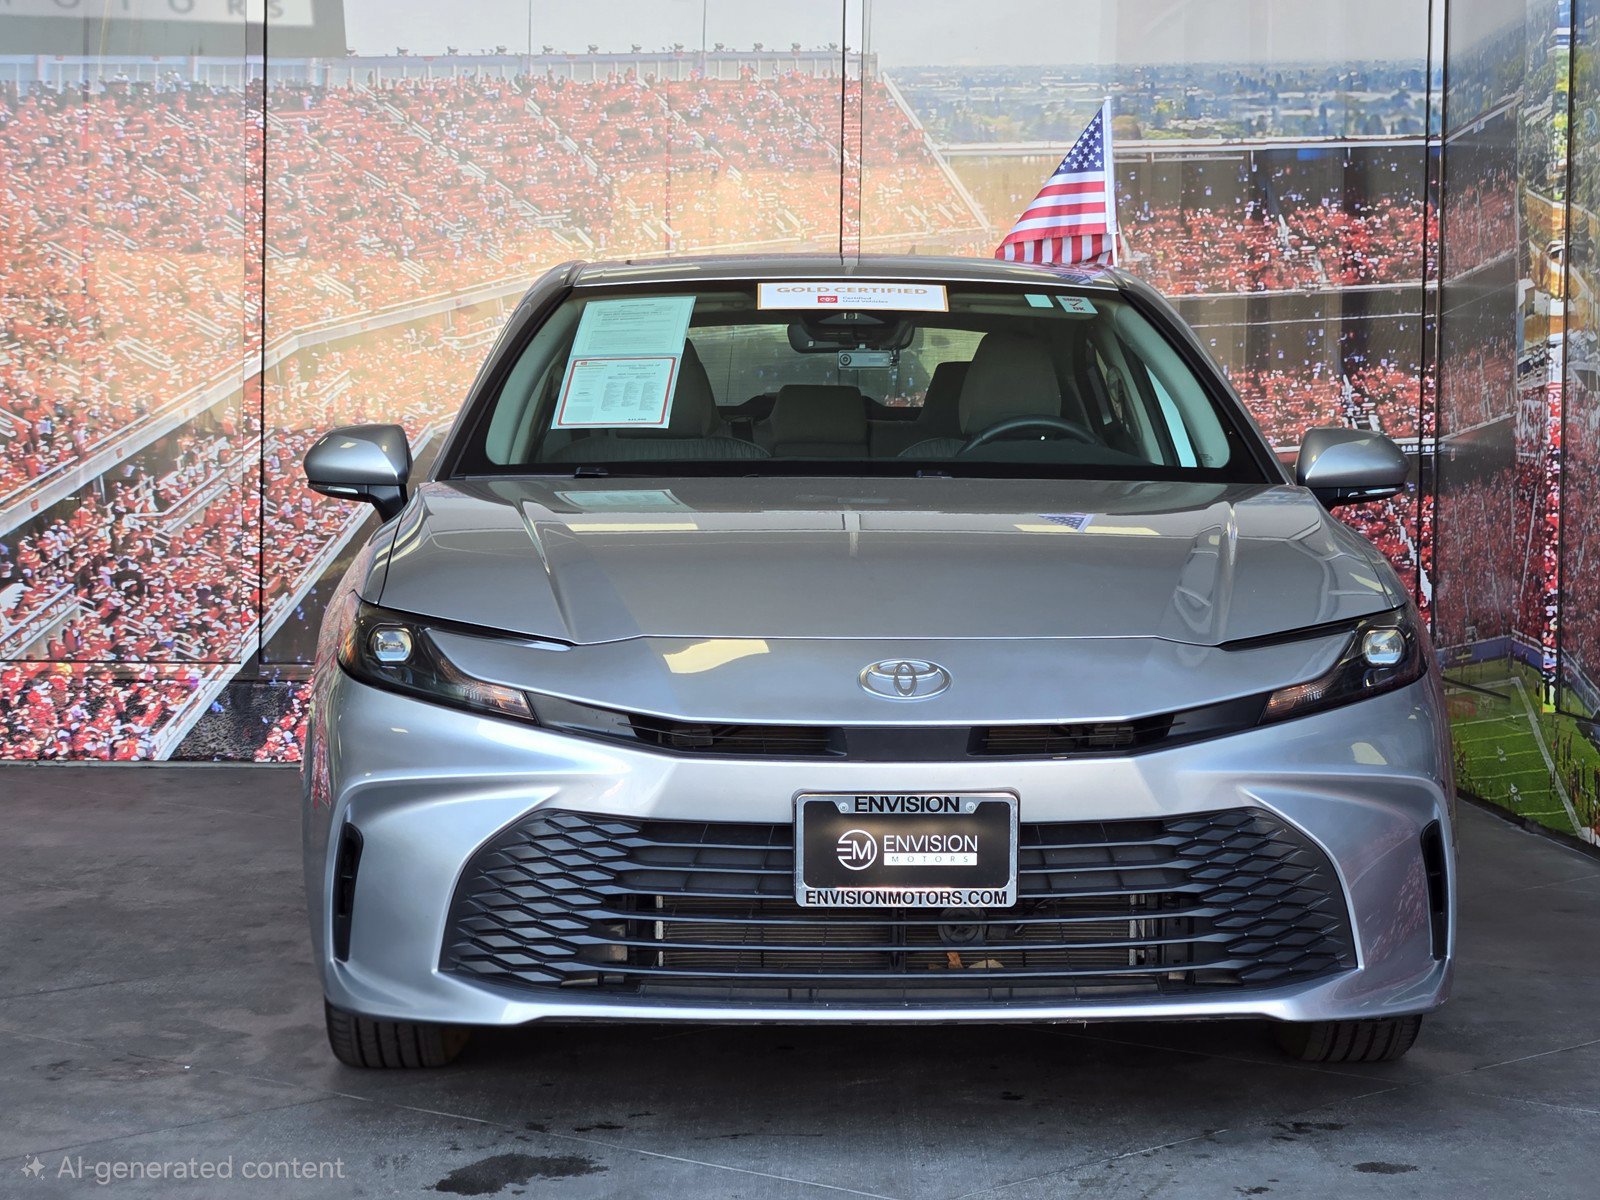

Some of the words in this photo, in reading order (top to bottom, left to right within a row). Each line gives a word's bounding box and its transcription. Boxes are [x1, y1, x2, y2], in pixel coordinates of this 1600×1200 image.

[854, 796, 960, 813] ENVISION
[883, 835, 978, 852] ENVISION
[891, 855, 969, 863] MOTORS
[805, 890, 1008, 905] ENVISIONMOTORS.COM
